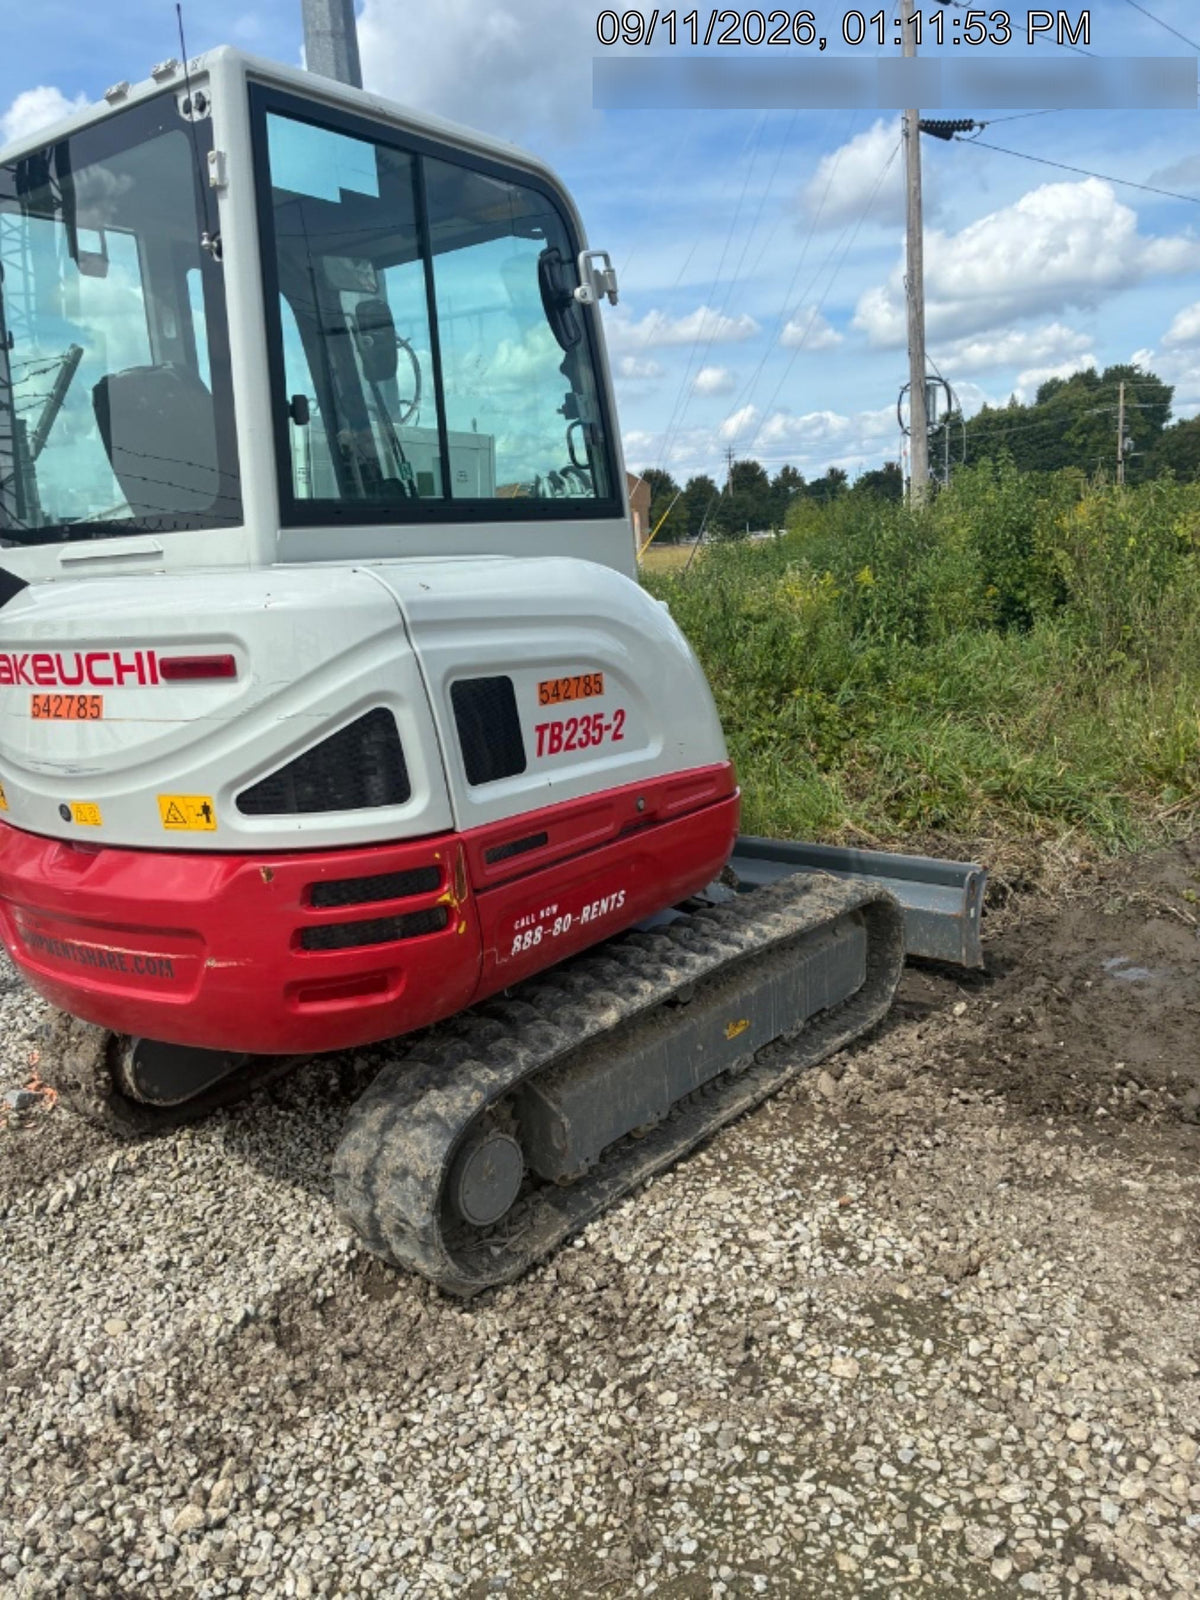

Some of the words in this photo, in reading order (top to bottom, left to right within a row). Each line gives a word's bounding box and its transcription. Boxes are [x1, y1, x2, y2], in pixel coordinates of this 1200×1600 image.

[539, 673, 603, 704] 542785
[32, 694, 101, 719] 542785
[535, 709, 626, 757] TB235-2
[514, 913, 536, 930] CALL
[539, 904, 558, 919] NOW
